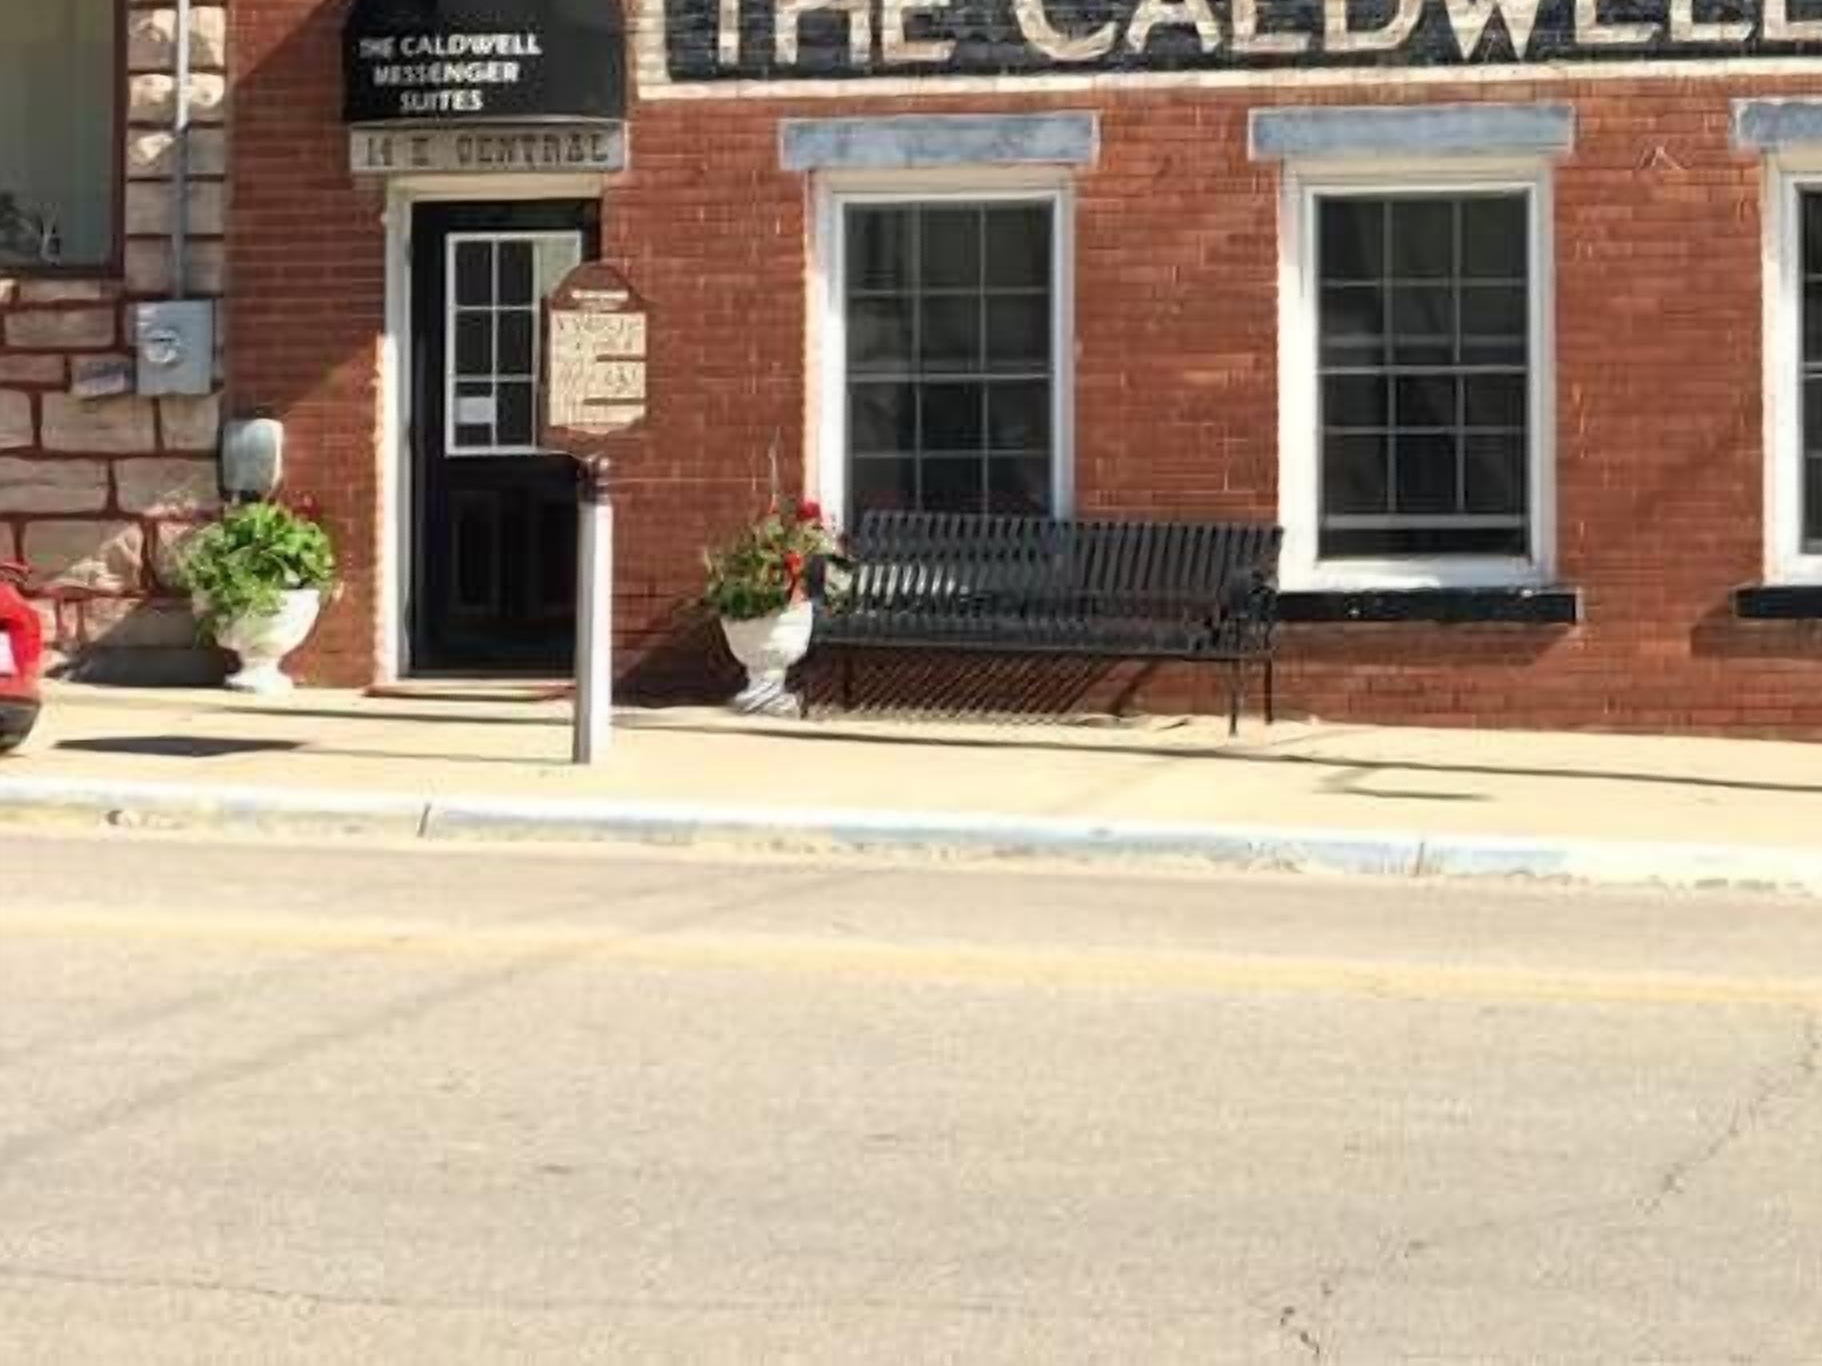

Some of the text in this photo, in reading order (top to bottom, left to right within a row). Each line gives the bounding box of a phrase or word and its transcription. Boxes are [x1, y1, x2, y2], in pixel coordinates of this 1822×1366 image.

[358, 32, 543, 58] THE CALDWELL
[372, 61, 520, 86] MESSENGER
[400, 89, 484, 112] SUITES
